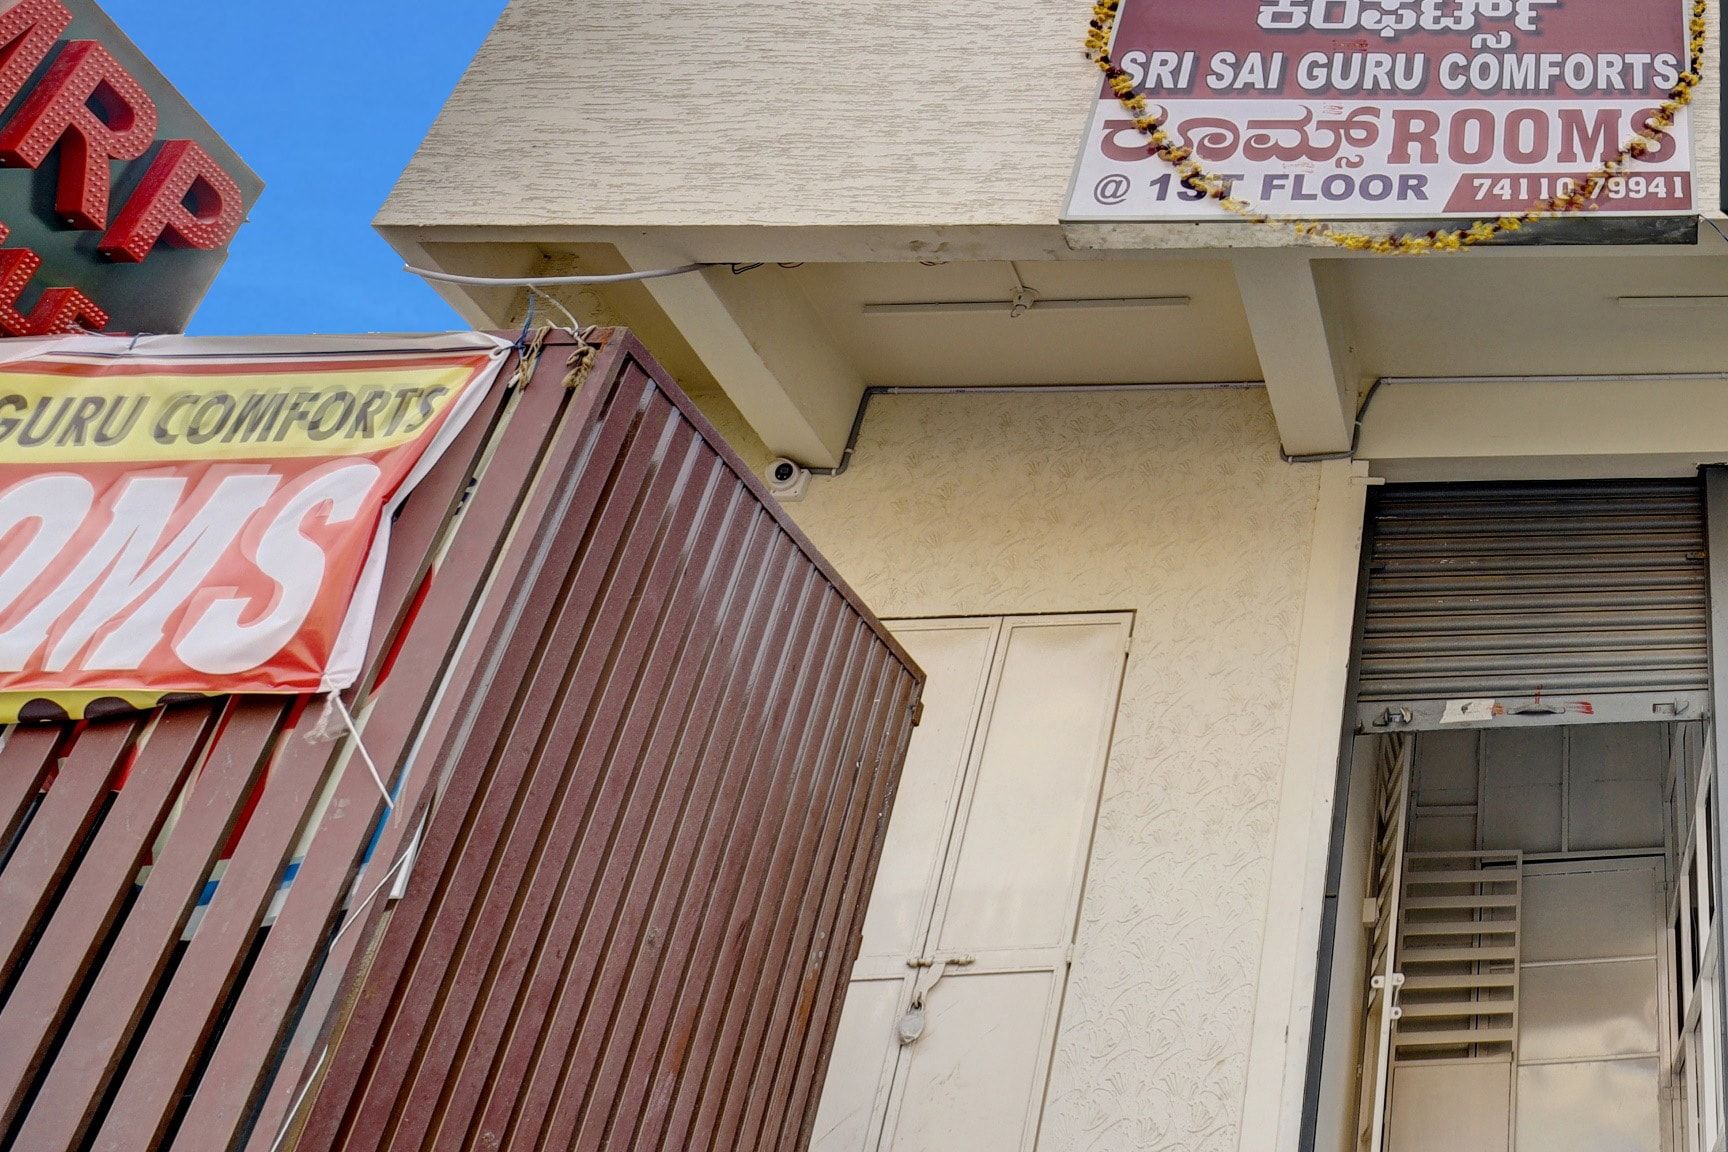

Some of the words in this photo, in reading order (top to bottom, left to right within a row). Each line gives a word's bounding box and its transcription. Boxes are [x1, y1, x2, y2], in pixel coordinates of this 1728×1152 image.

[1121, 51, 1193, 89] SRI
[1207, 51, 1283, 89] SAI
[1296, 52, 1424, 90] GURU
[1438, 52, 1680, 92] COMFORTS
[1388, 109, 1676, 165] ROOMS
[1149, 173, 1244, 201] 1ST
[1260, 173, 1430, 201] FLOOR
[153, 384, 450, 445] COMFORTS
